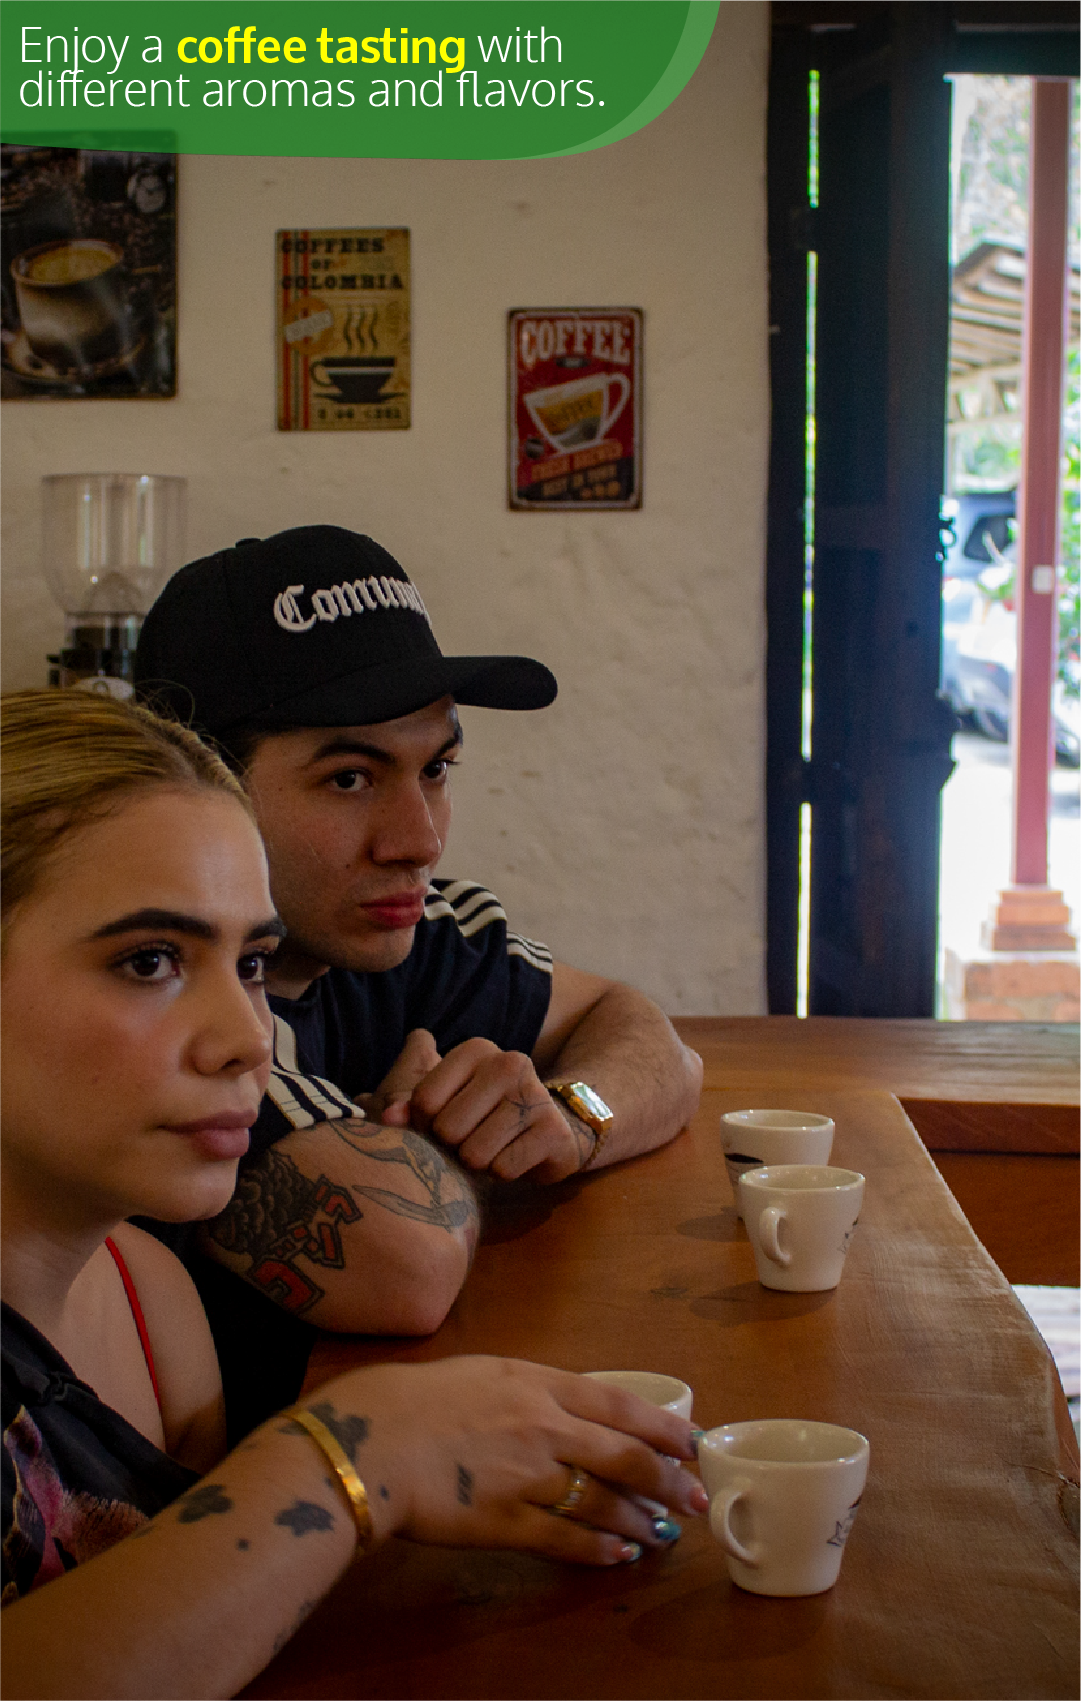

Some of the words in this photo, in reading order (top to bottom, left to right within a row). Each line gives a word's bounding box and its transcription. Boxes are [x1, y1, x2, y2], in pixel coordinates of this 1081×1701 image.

[282, 238, 385, 254] COFFEES
[282, 273, 404, 290] COLOMBIA
[521, 318, 631, 369] COFFEE
